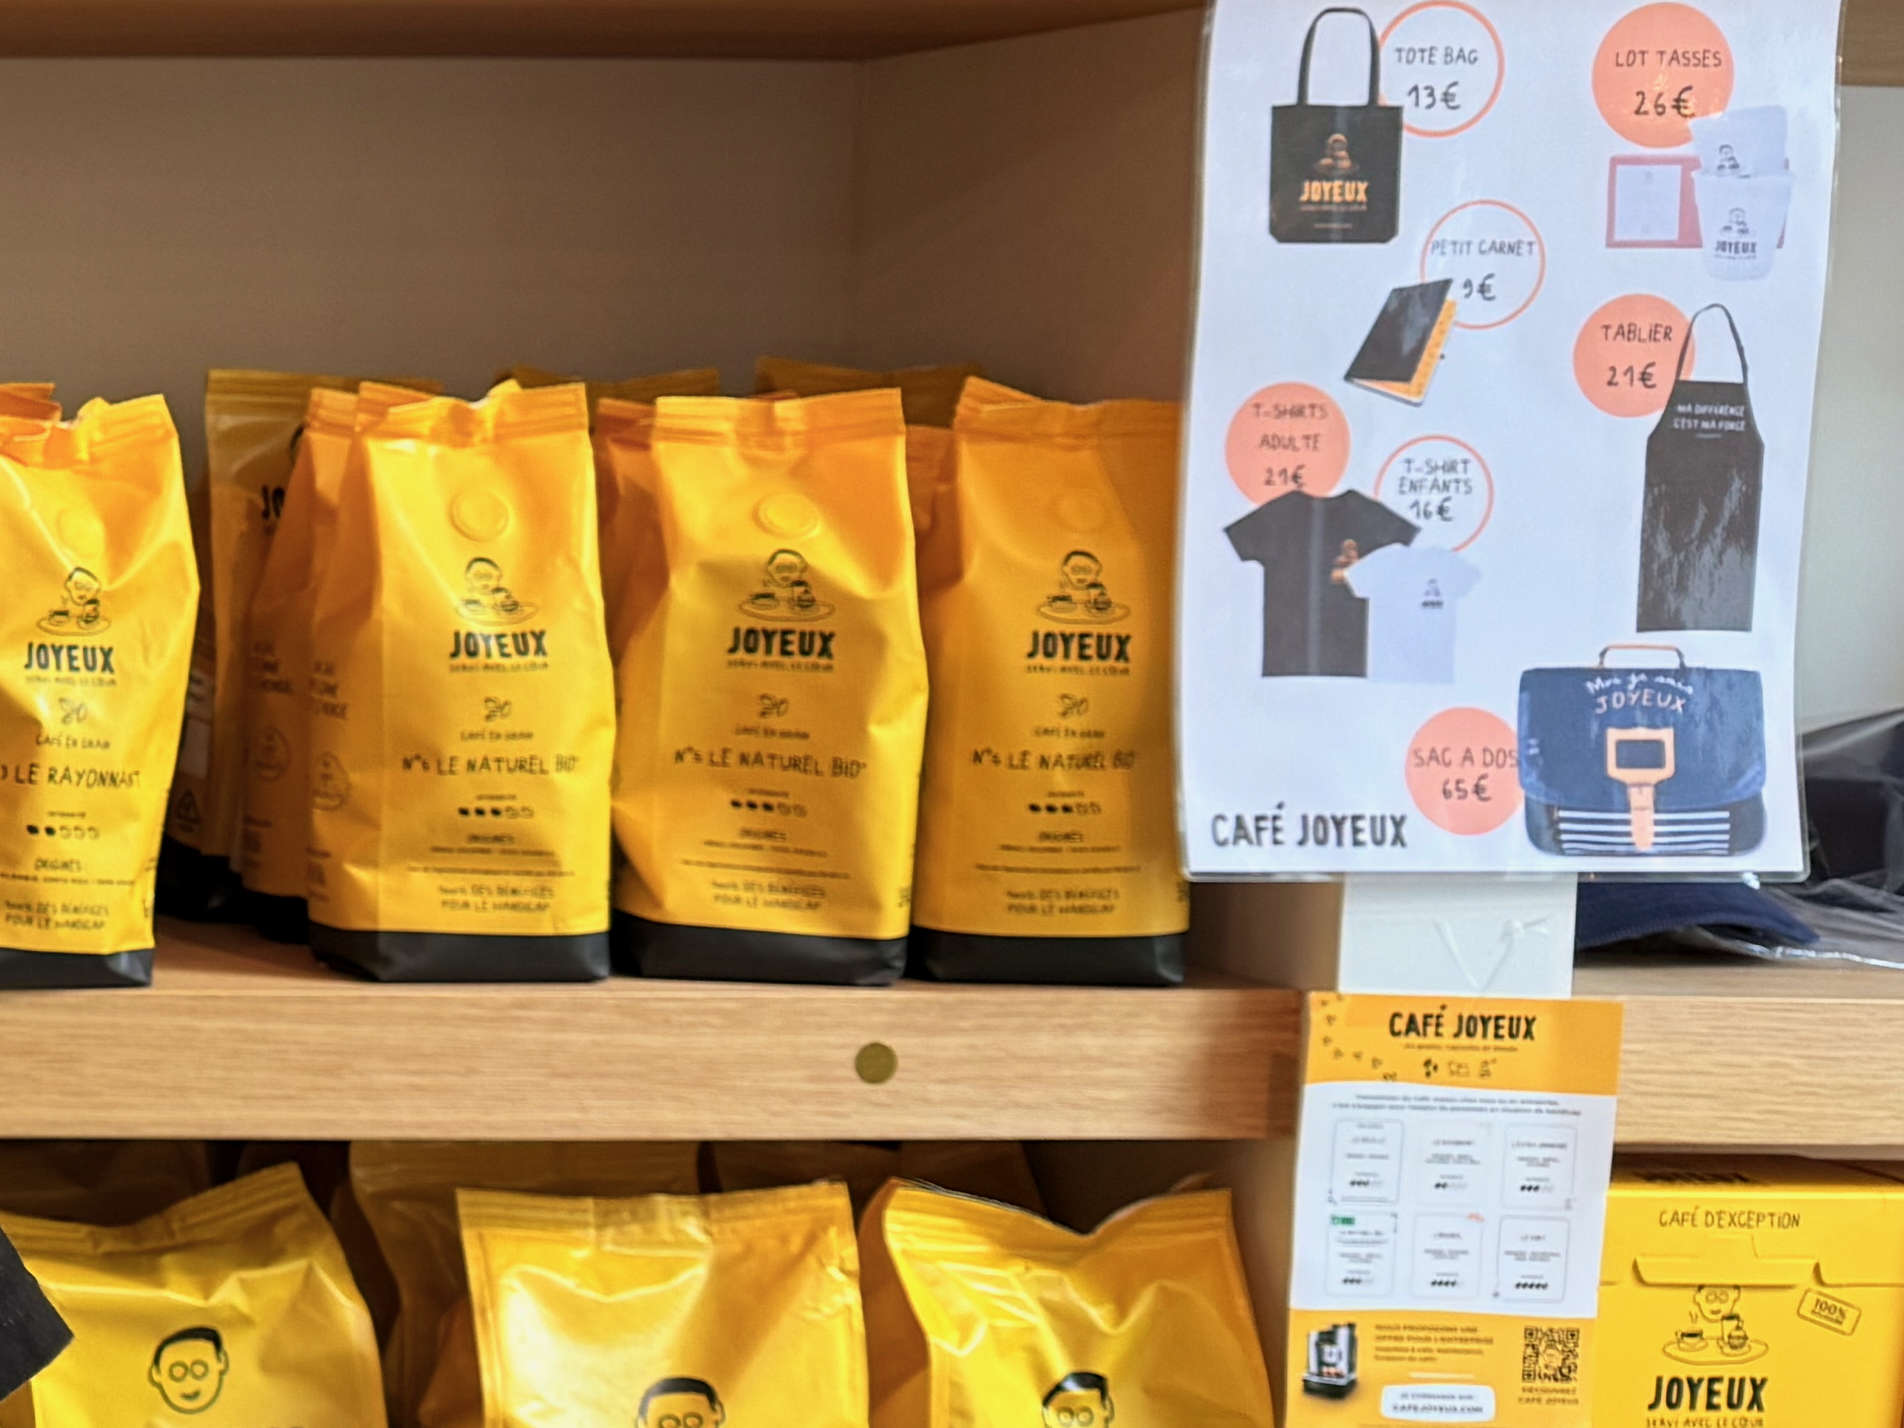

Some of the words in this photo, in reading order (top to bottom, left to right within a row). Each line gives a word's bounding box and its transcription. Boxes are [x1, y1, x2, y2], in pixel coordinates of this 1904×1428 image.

[1395, 46, 1438, 65] TOTE
[1444, 46, 1478, 65] BAG
[1615, 49, 1649, 67] LOT
[1656, 49, 1722, 68] TASSES
[1407, 81, 1460, 110] 13€
[1634, 85, 1696, 119] 26€
[1300, 180, 1368, 202] JOYEUX
[1431, 239, 1474, 258] PETIT
[1478, 239, 1536, 257] CARNET
[1607, 361, 1657, 389] 21€
[1410, 496, 1452, 522] 16€
[24, 641, 114, 674] JOYEUX
[449, 629, 547, 659] JOYEUX
[1412, 746, 1452, 768] SAC
[1489, 748, 1518, 771] DOS
[14, 762, 40, 785] LE
[47, 766, 140, 789] RAYONNANT
[1441, 779, 1493, 804] 65€
[1211, 801, 1285, 847] CAFÉ
[1297, 814, 1407, 848] JOYEUX
[1389, 1004, 1447, 1038] CAFÉ
[1453, 1014, 1536, 1041] JOYEUX
[1659, 1205, 1699, 1228] CAFÉ
[1648, 1376, 1768, 1412] JOYEUX
